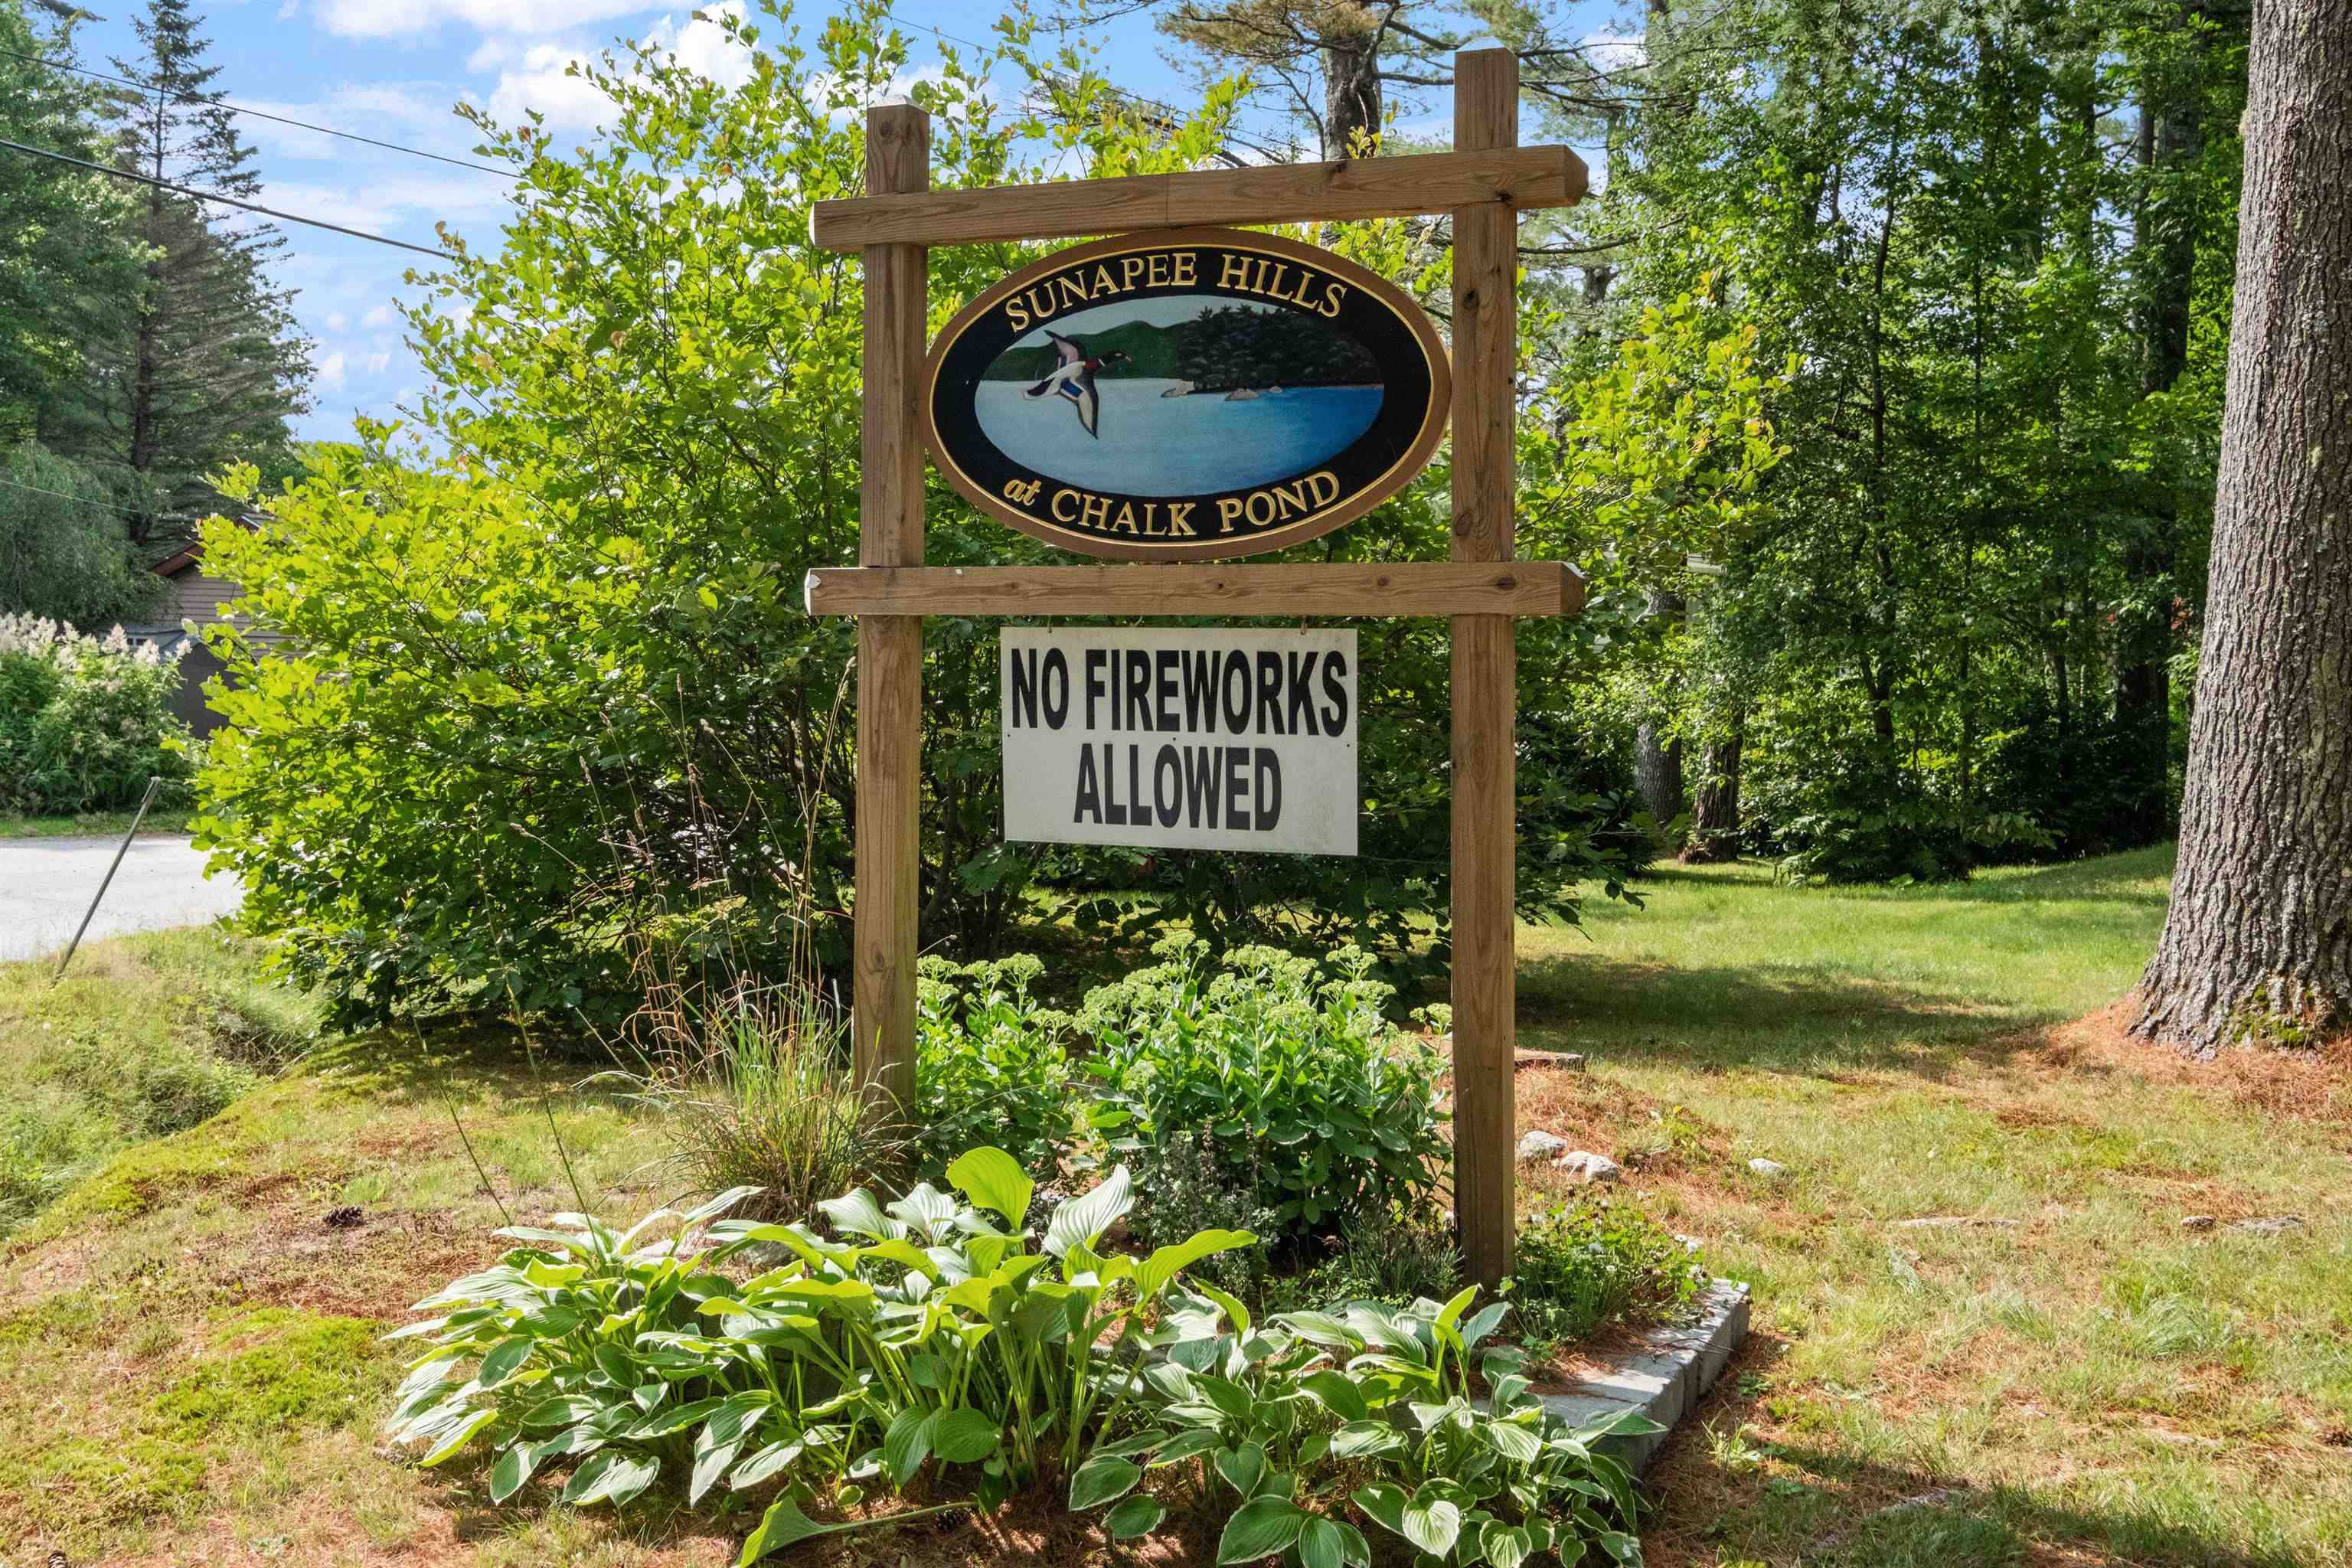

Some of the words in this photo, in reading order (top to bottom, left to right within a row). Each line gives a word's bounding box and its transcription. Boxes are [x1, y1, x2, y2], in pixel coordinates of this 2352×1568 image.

[1004, 252, 1198, 334] SUNAPEE
[1217, 254, 1348, 318] HILLS
[1003, 475, 1041, 508] at
[1050, 488, 1197, 536] CHALK
[1216, 469, 1341, 532] POND
[1011, 647, 1070, 730] NO
[1085, 648, 1348, 737] FIREWORKS
[1073, 743, 1282, 831] ALLOWED
